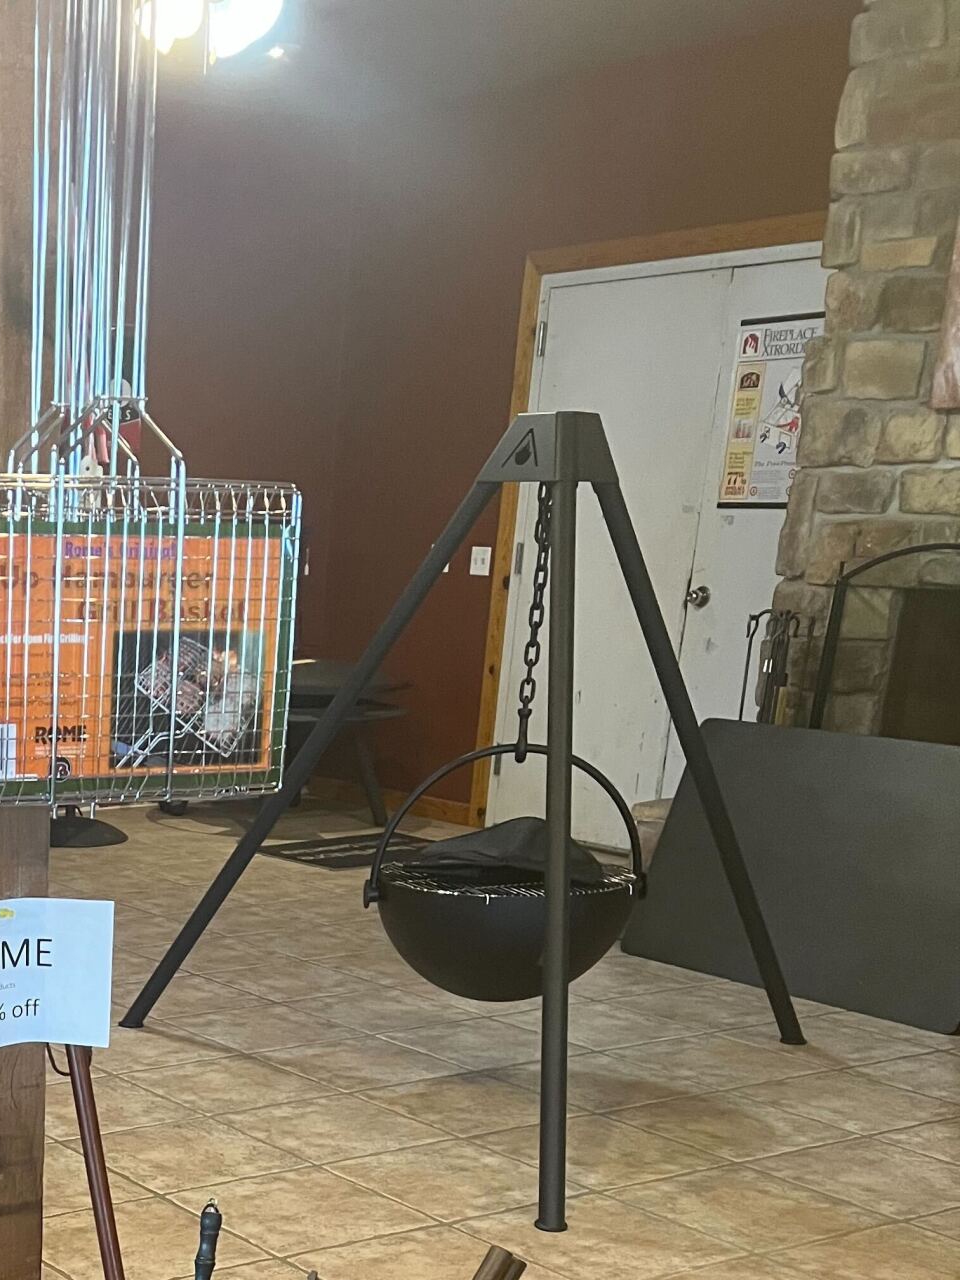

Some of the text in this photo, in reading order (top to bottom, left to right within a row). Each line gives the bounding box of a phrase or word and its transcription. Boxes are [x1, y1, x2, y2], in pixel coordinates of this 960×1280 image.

[764, 327, 819, 342] FIREPLACE
[35, 725, 88, 744] ROME
[12, 998, 40, 1019] off
